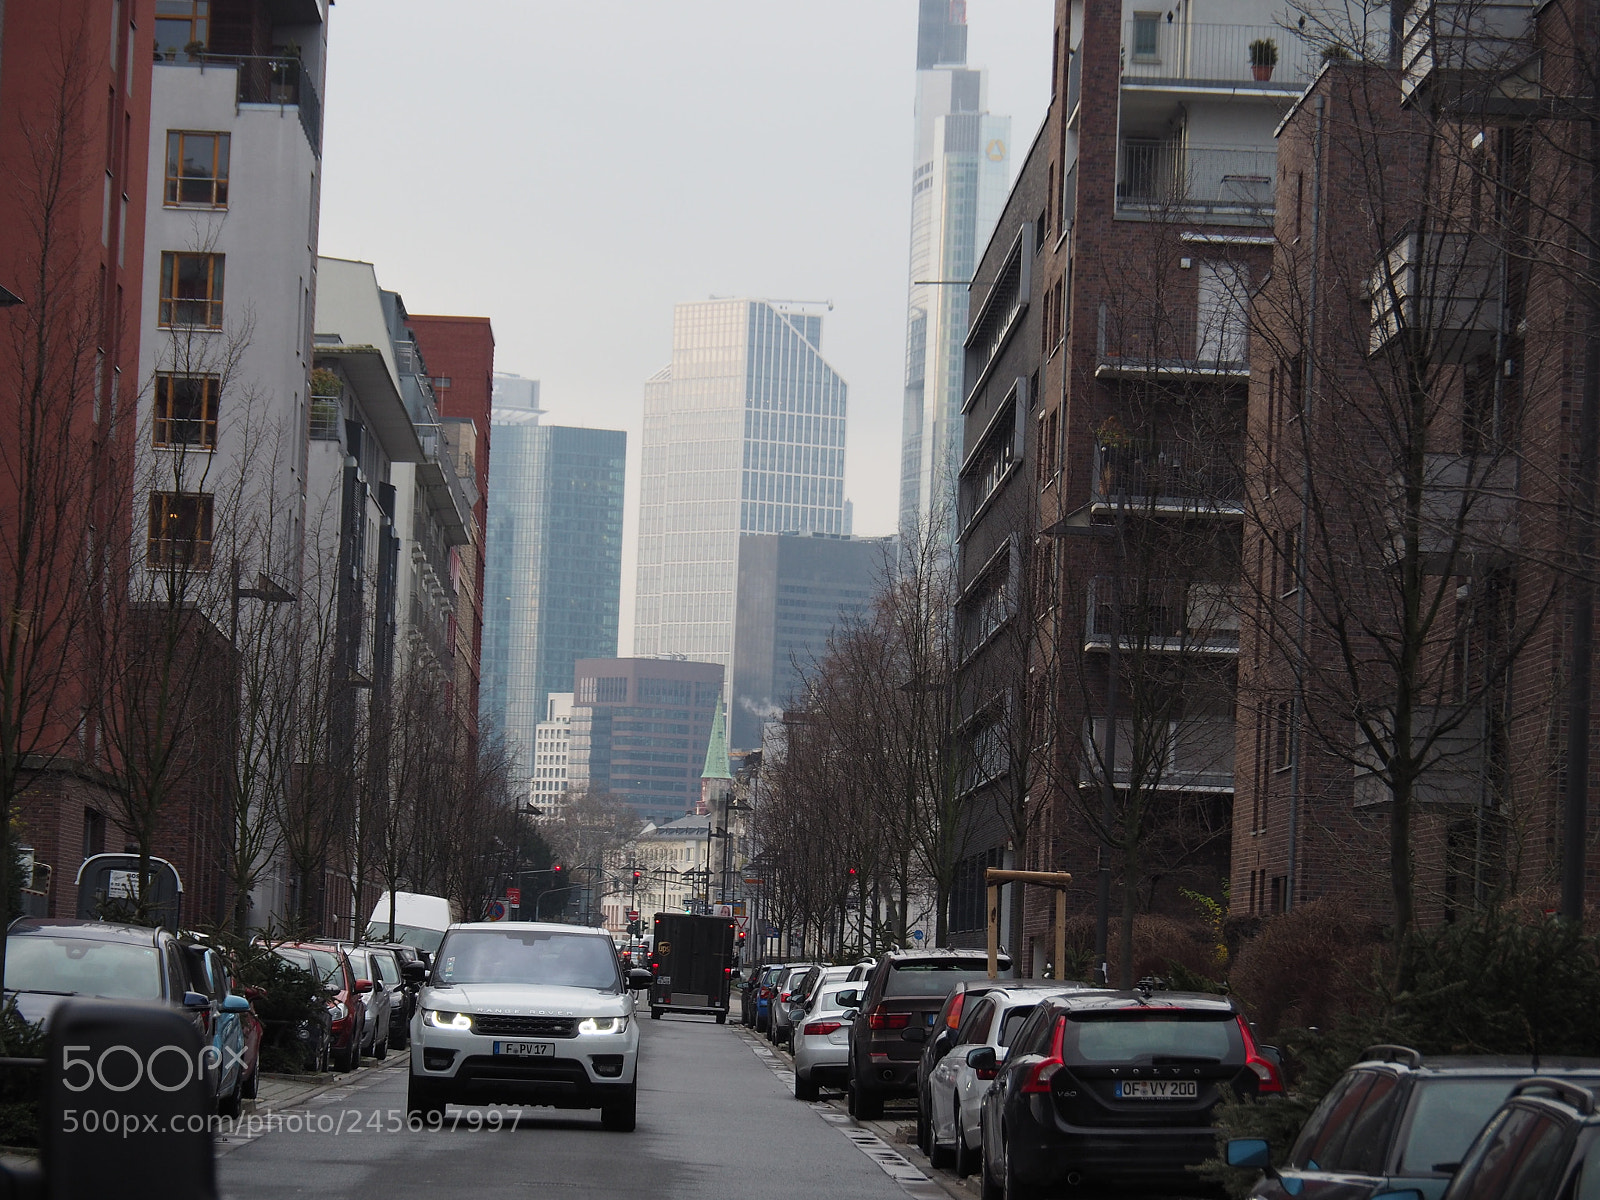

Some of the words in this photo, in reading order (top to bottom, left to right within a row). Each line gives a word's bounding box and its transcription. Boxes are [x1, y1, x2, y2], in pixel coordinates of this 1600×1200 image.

[1123, 1083, 1141, 1096] OF
[1150, 1083, 1167, 1095] VY
[1171, 1082, 1196, 1095] 200
